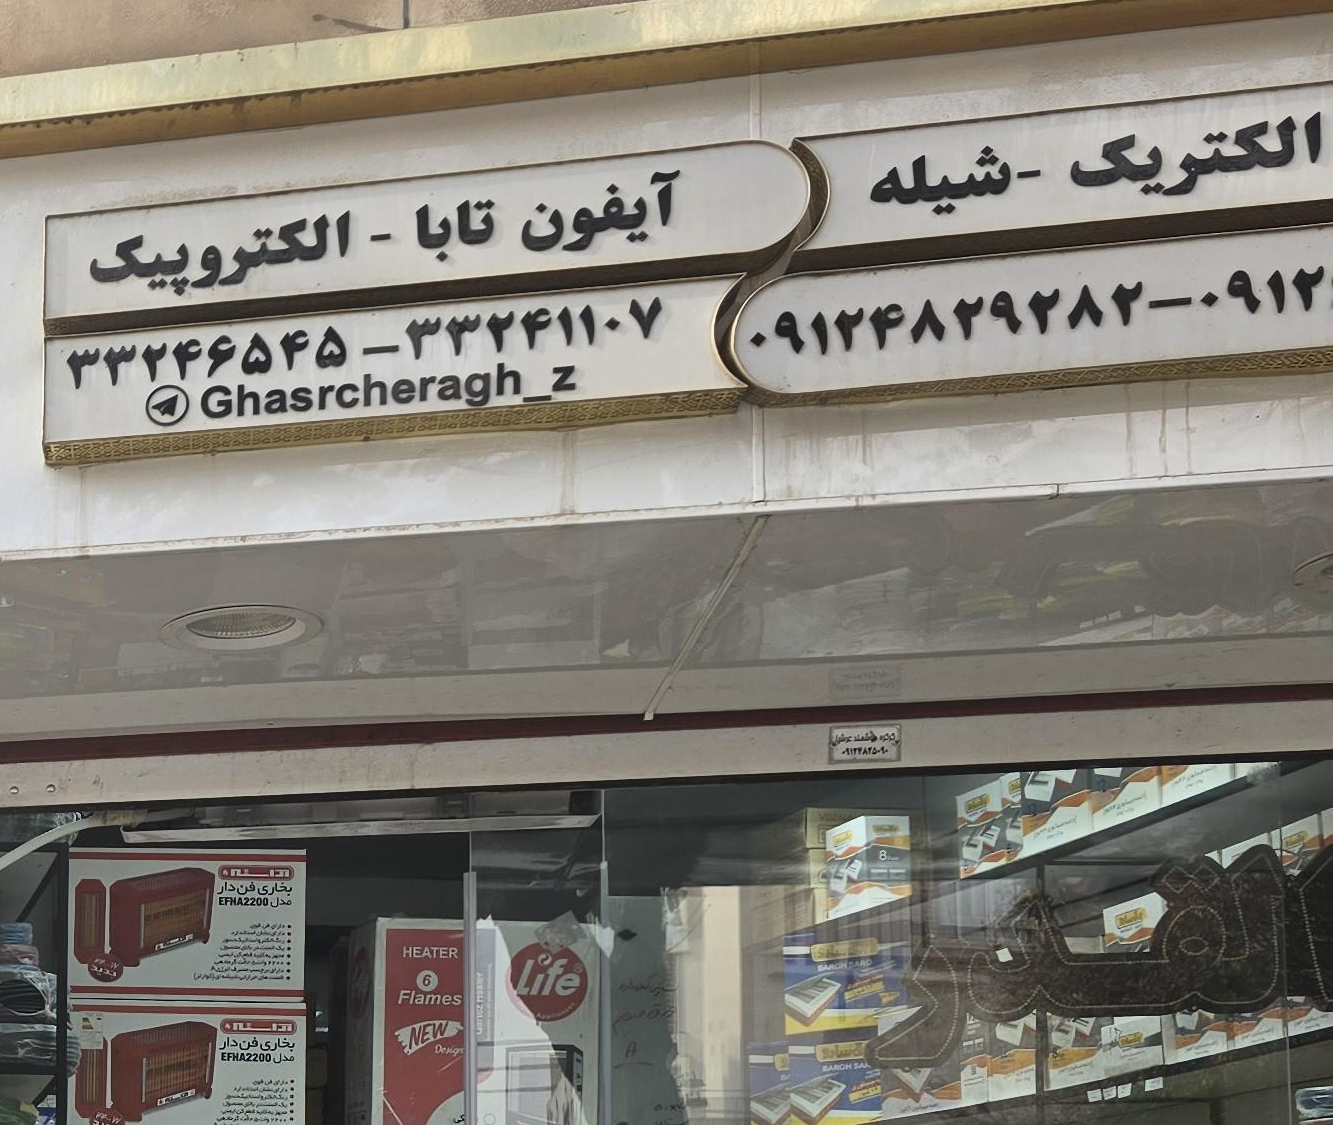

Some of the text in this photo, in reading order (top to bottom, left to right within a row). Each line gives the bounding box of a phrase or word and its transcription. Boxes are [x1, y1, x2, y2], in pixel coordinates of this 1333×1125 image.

[1070, 111, 1320, 196] الکتریک
[90, 170, 680, 295] آیفون تابا الکتروپیک
[201, 363, 577, 421] Ghasrcheragh_z
[258, 883, 292, 896] بخاری
[219, 897, 291, 907] مدل EFHA2200
[403, 947, 458, 959] HEATER
[422, 975, 431, 986] 6
[517, 954, 581, 996] Life
[398, 990, 462, 1006] Flames
[409, 1022, 448, 1049] NEW
[259, 1037, 295, 1050] بخاری
[221, 1053, 294, 1064] مدل EFHA2200
